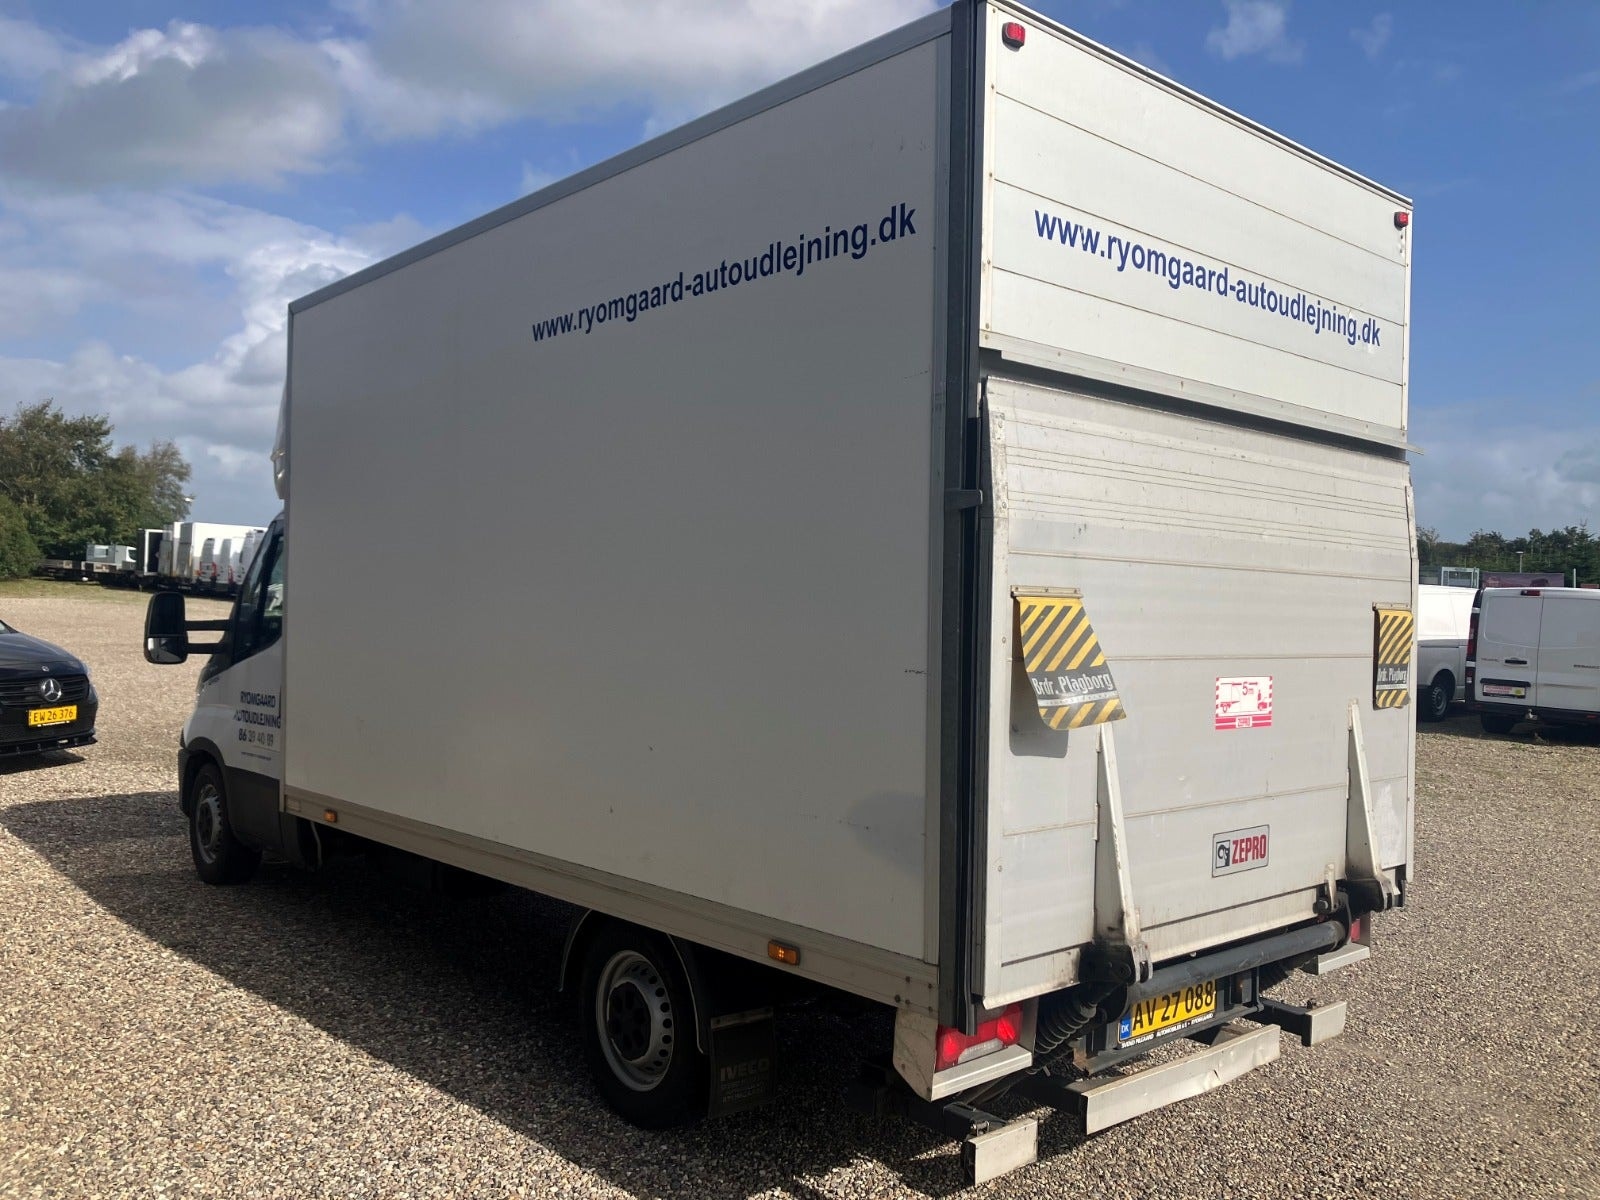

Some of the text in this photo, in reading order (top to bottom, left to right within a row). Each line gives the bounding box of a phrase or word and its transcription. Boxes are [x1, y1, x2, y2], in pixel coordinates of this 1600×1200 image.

[532, 203, 917, 342] www.ryomgaard-autoudlejning.dk
[1035, 209, 1381, 347] www.ryomgaard-autoudlejning.dk
[1031, 673, 1114, 696] Brdr. Plagborg
[33, 709, 74, 722] EW 26 376
[1231, 834, 1267, 864] ZEPRO
[1133, 981, 1213, 1031] AV 27 088
[1121, 1023, 1130, 1034] DK
